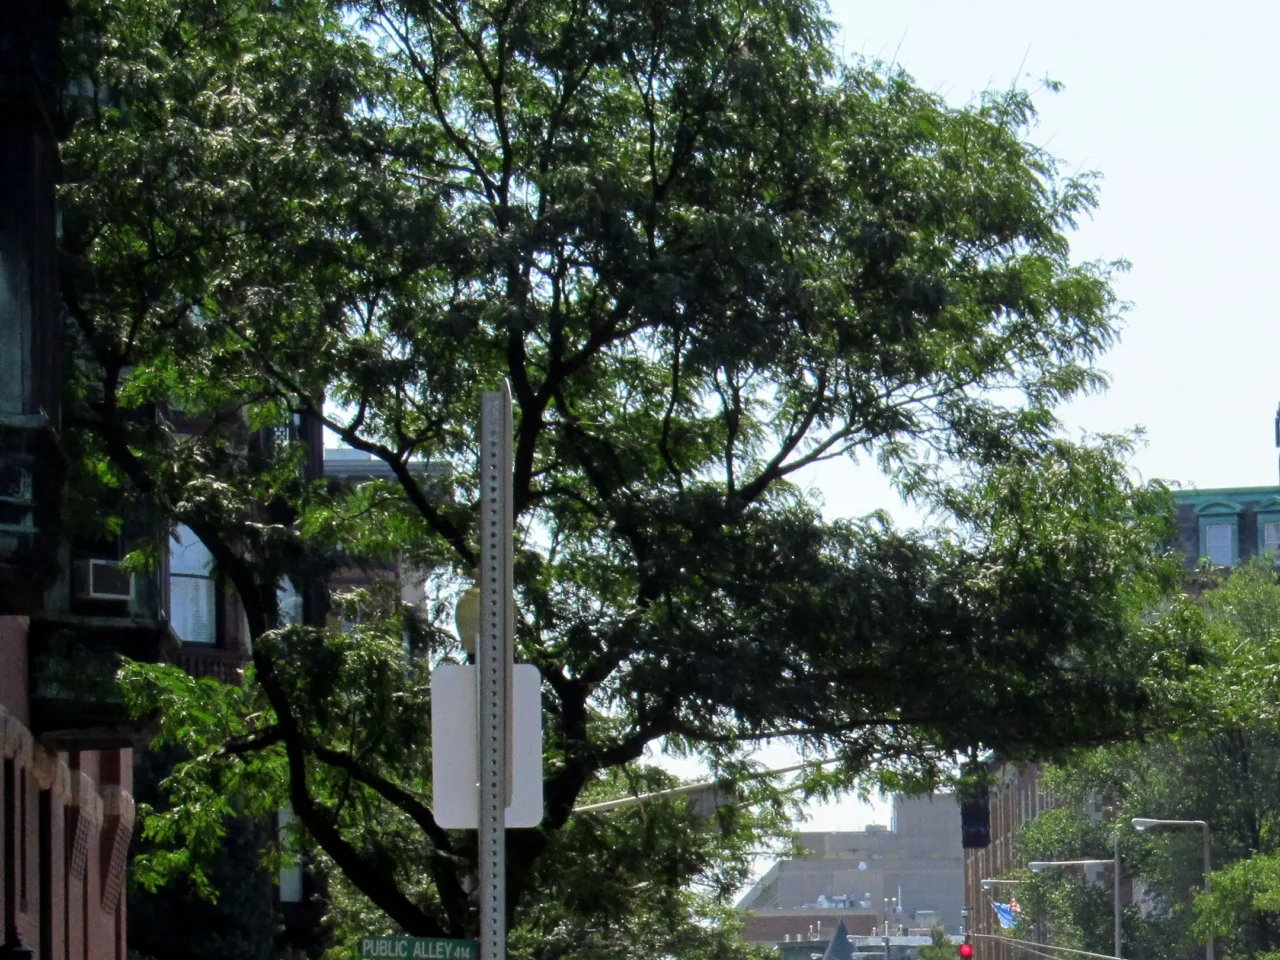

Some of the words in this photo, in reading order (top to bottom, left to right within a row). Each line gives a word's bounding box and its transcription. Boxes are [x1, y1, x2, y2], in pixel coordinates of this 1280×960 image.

[362, 940, 409, 957] PUBLIC
[413, 941, 453, 959] ALLEY
[454, 946, 470, 959] 414
